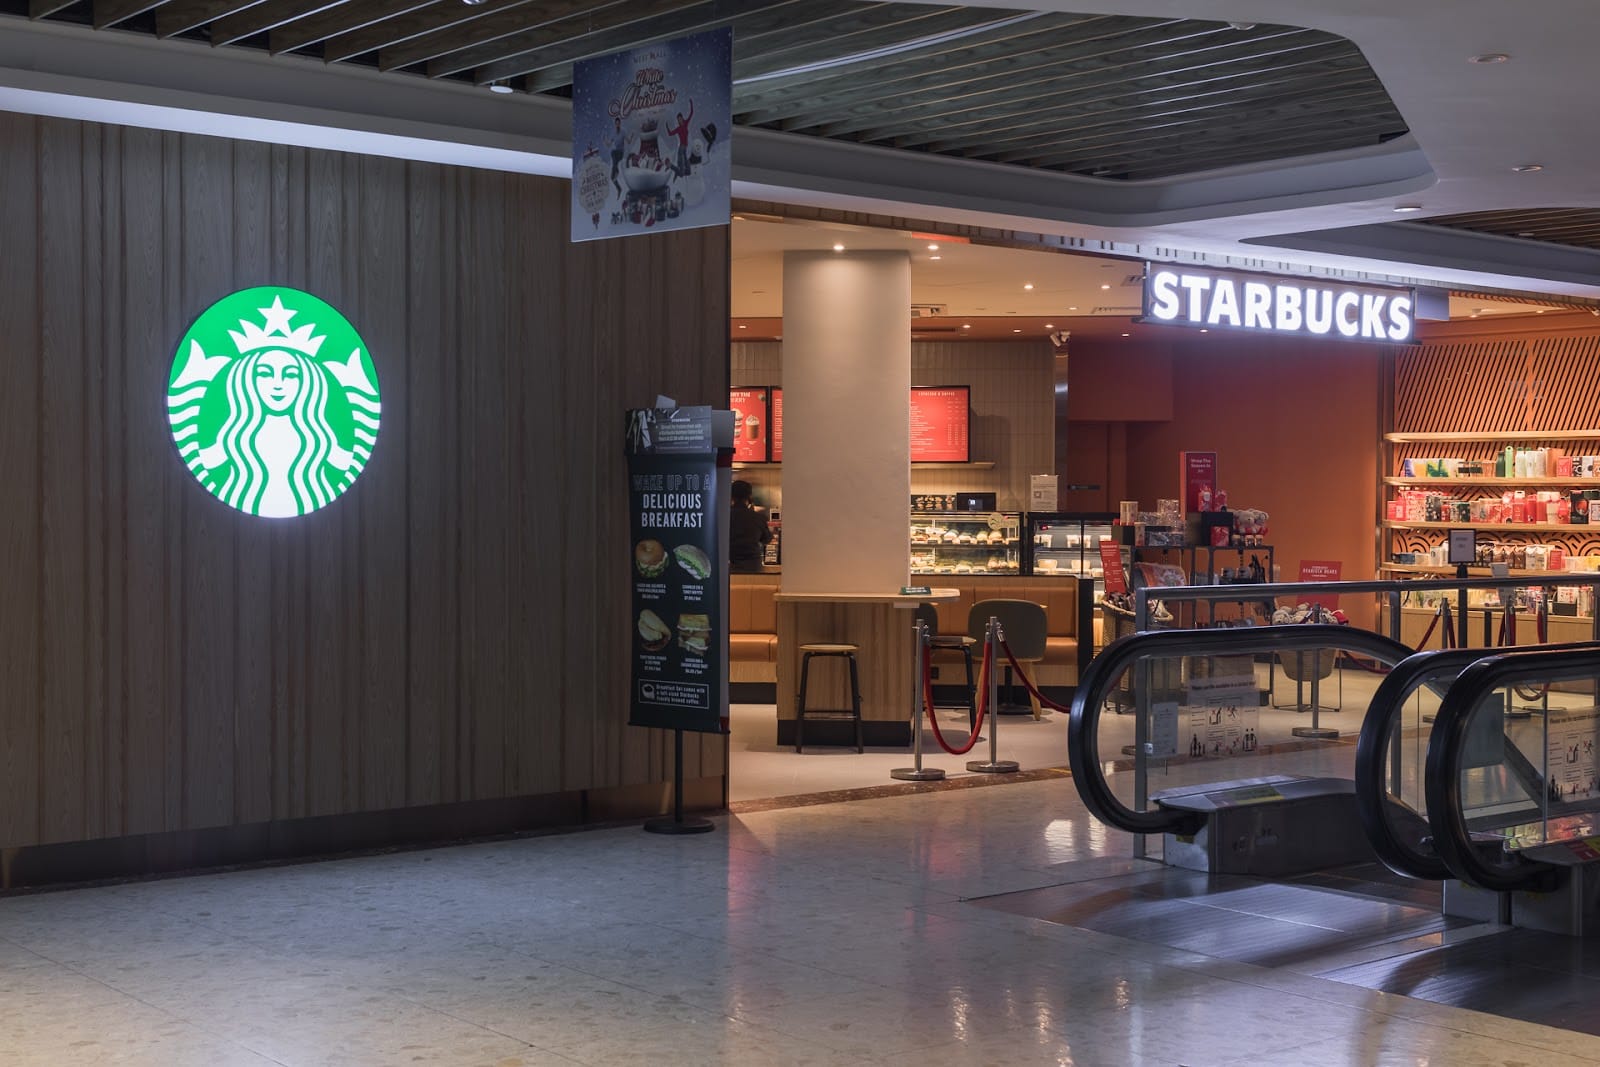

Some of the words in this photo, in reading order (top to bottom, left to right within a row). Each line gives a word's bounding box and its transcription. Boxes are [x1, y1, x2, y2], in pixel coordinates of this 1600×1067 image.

[1153, 271, 1411, 340] STARBUCKS
[643, 494, 702, 509] DELICIOUS
[641, 512, 704, 528] BREAKFAST
